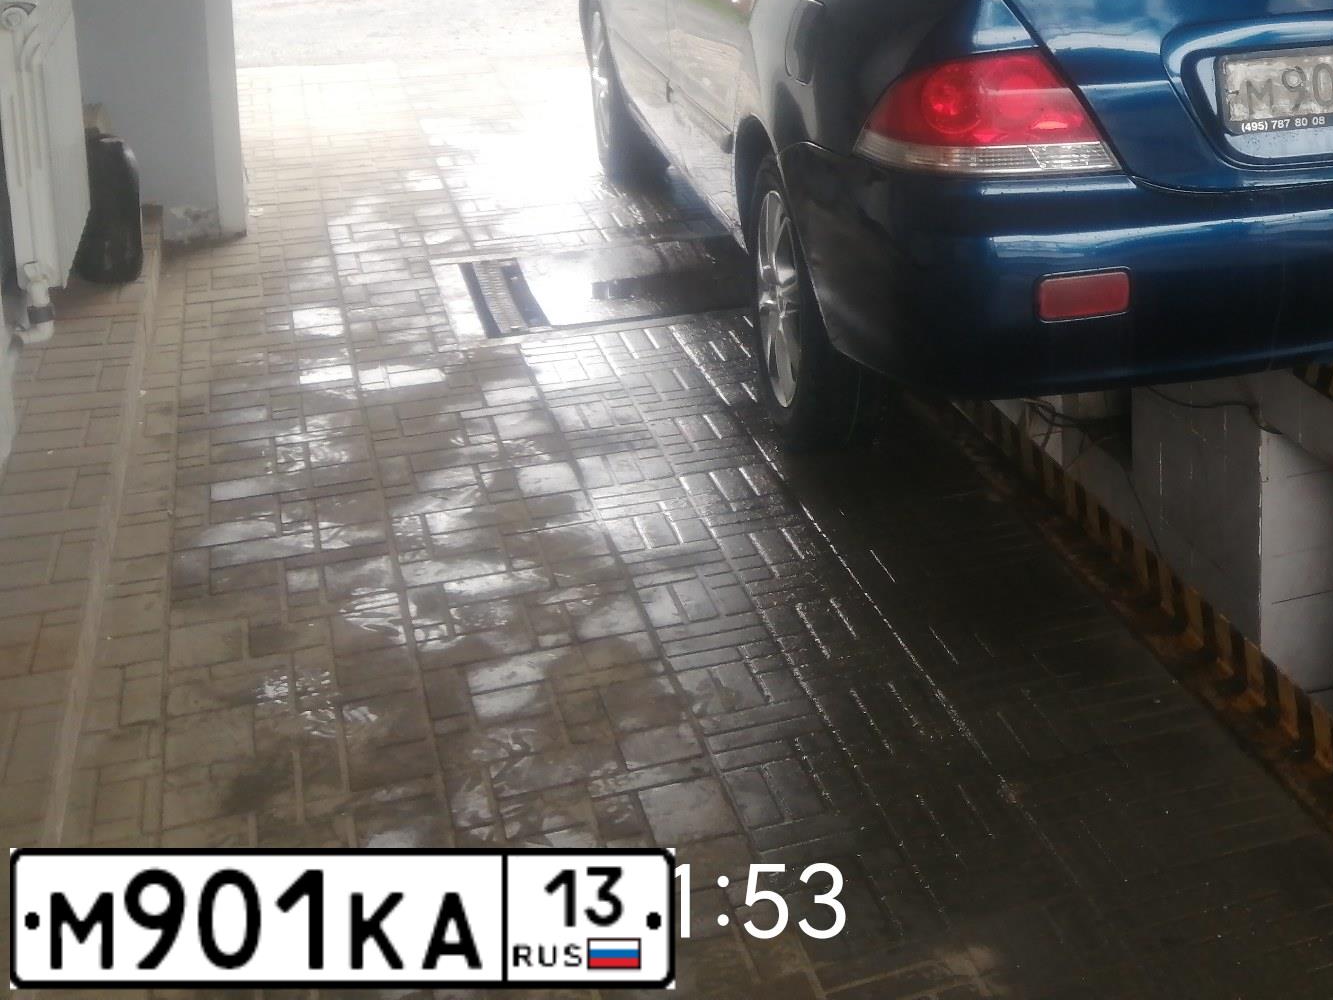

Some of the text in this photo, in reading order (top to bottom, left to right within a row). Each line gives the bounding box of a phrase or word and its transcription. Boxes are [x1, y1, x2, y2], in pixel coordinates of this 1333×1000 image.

[1241, 116, 1326, 133] (495) 787 80 08
